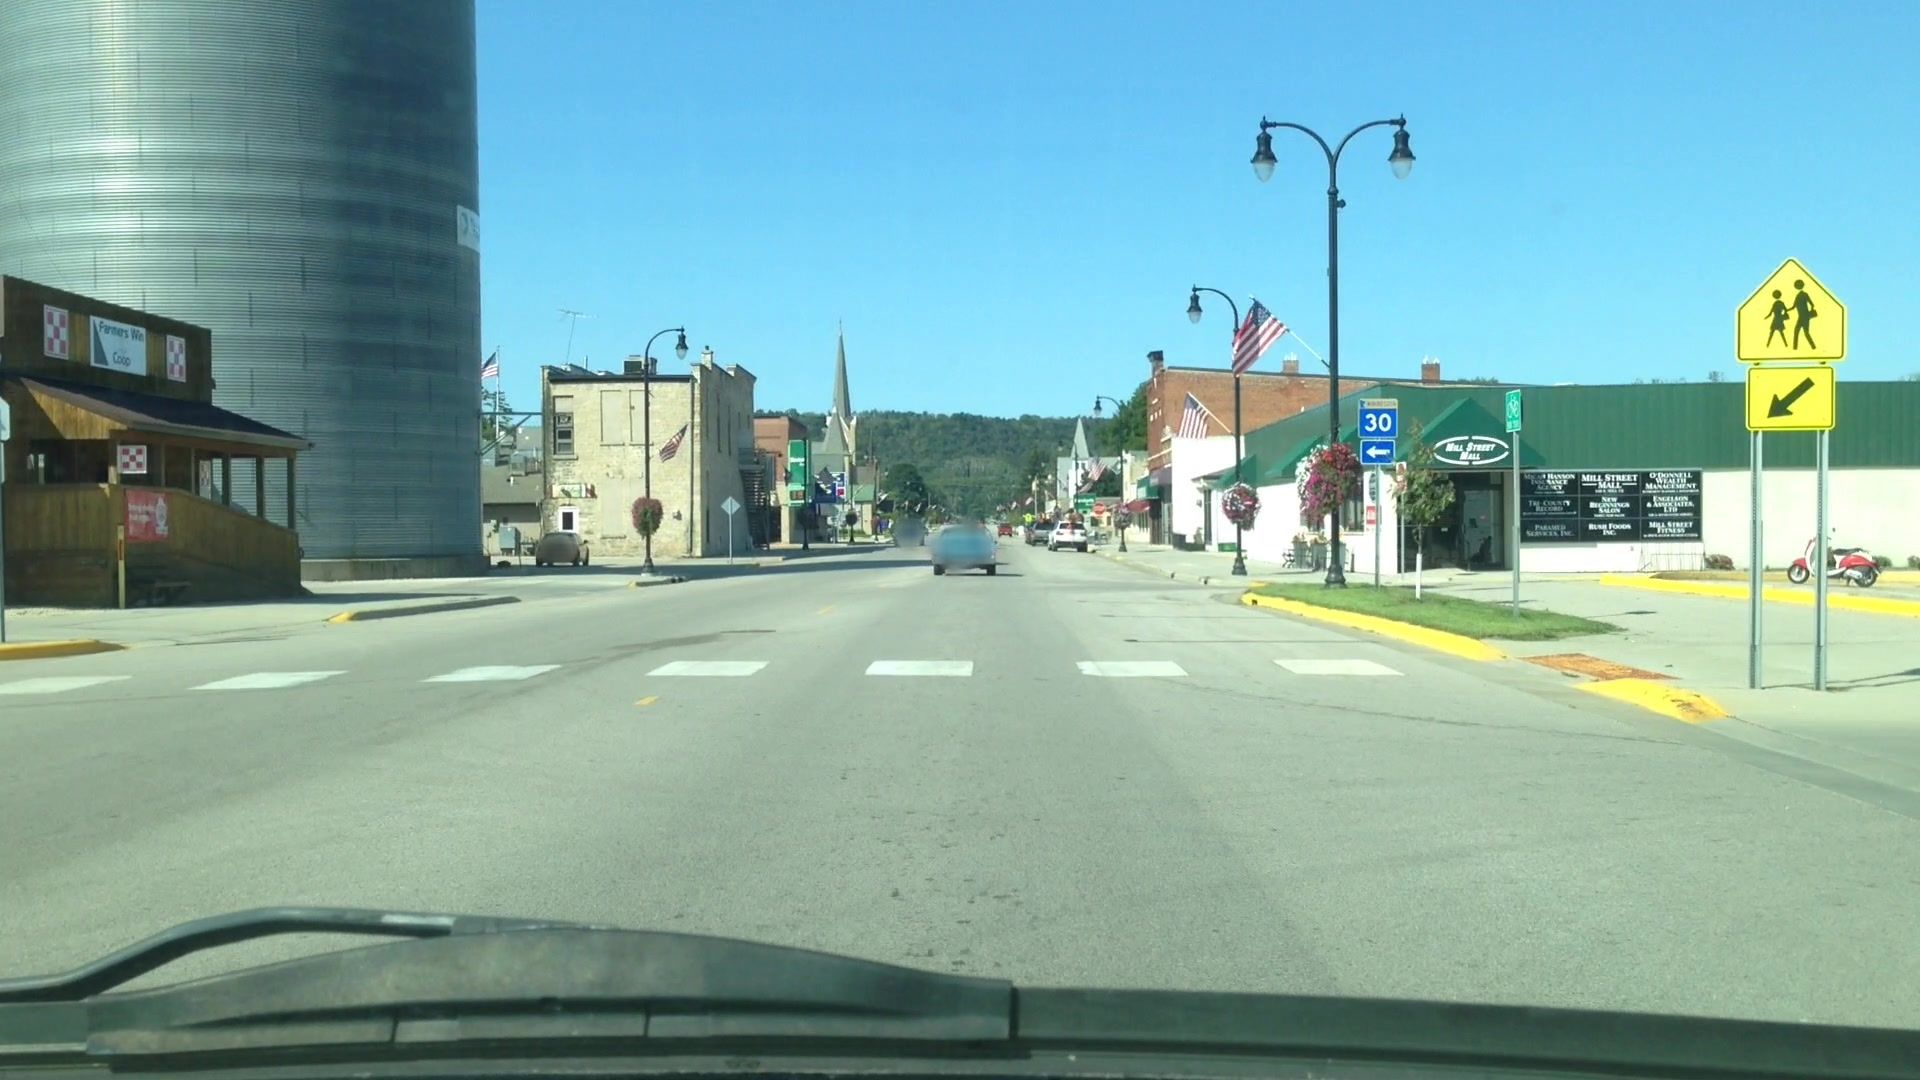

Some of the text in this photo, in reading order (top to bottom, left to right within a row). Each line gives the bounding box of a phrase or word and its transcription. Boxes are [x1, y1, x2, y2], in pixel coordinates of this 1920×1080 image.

[99, 321, 144, 341] Farmers Win
[112, 352, 131, 367] Coop
[1364, 413, 1392, 432] 30
[1445, 442, 1496, 452] MILL STREET
[1459, 451, 1480, 460] MALL
[1581, 473, 1638, 482] MILL STREET
[1597, 481, 1622, 489] MALL
